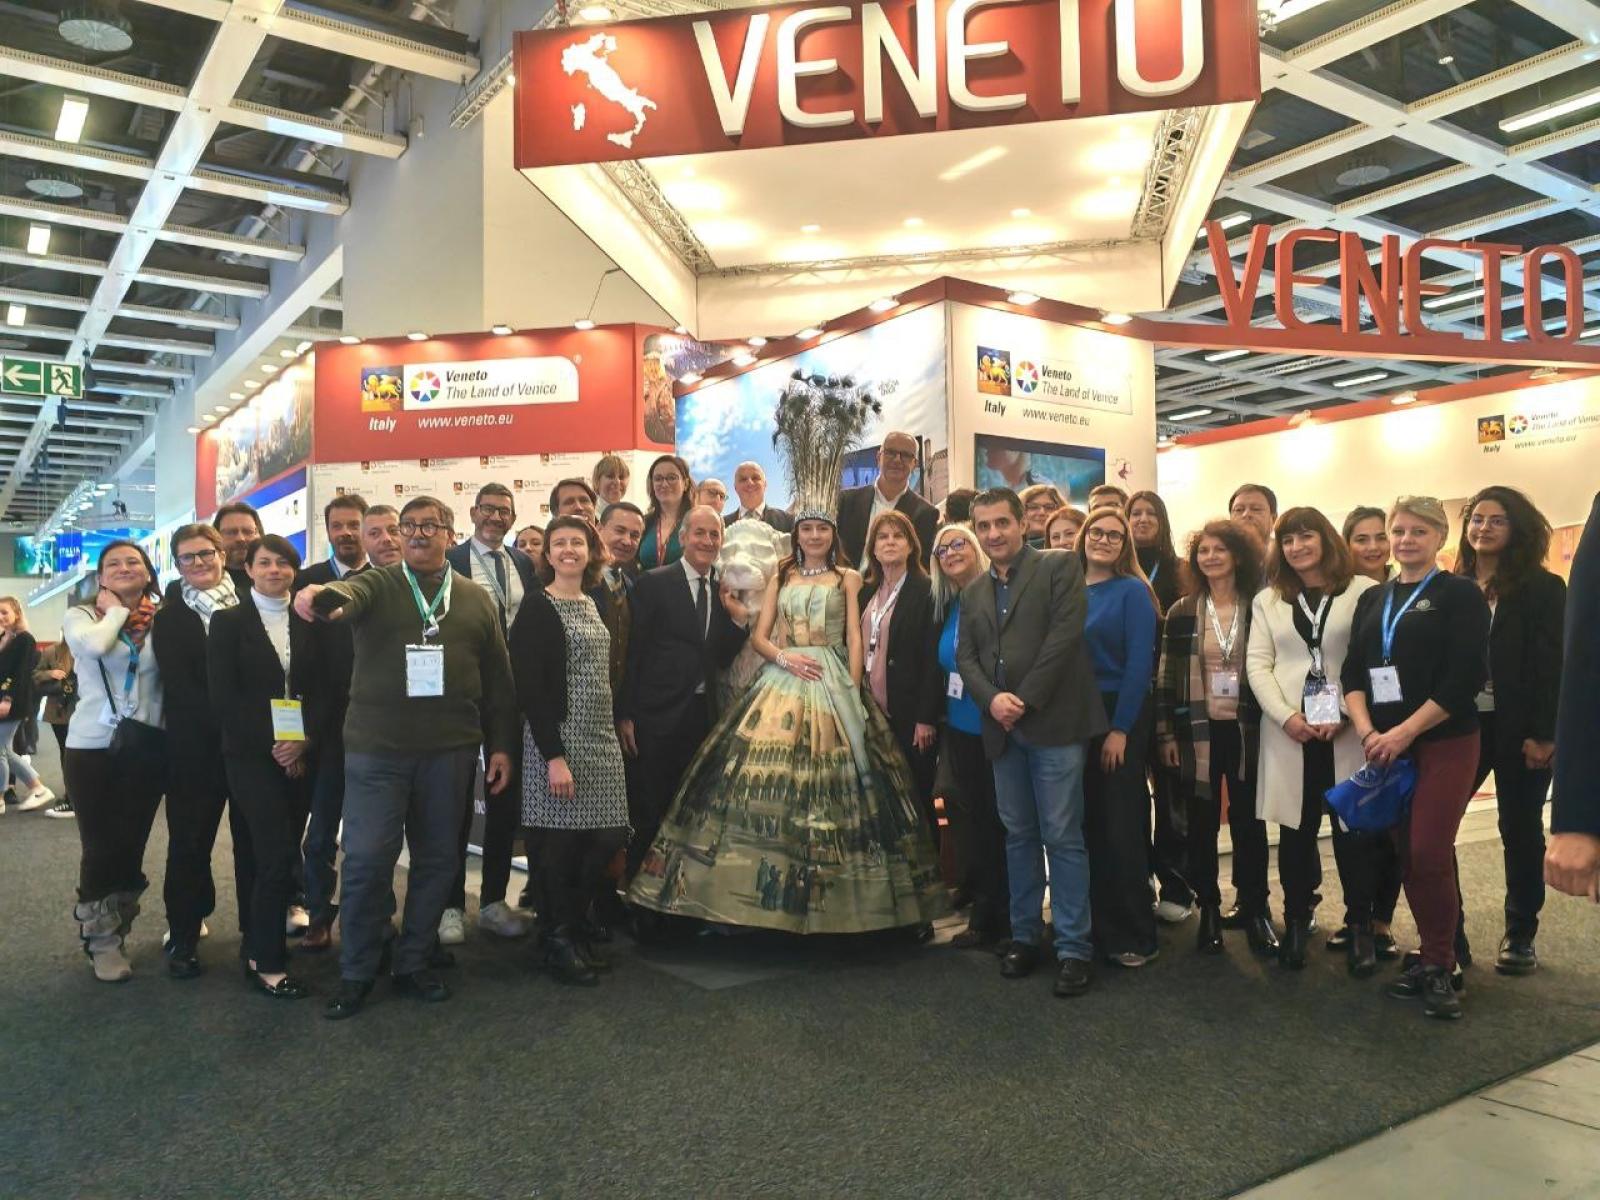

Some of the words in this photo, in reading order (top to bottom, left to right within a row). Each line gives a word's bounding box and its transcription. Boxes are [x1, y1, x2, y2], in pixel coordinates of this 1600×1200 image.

[1205, 220, 1584, 344] VENETO
[446, 370, 488, 383] Veneto
[1041, 365, 1072, 381] Veneto
[447, 386, 467, 399] The
[471, 385, 500, 398] Land
[502, 383, 515, 397] of
[518, 382, 557, 396] Venice
[1042, 381, 1058, 396] The
[1060, 384, 1081, 399] Land
[1082, 387, 1091, 400] of
[1092, 389, 1119, 405] Venice
[984, 400, 1006, 416] Italy
[1023, 407, 1090, 426] www.veneto.eu
[369, 415, 397, 433] Italy
[418, 413, 514, 429] www.veneto.eu
